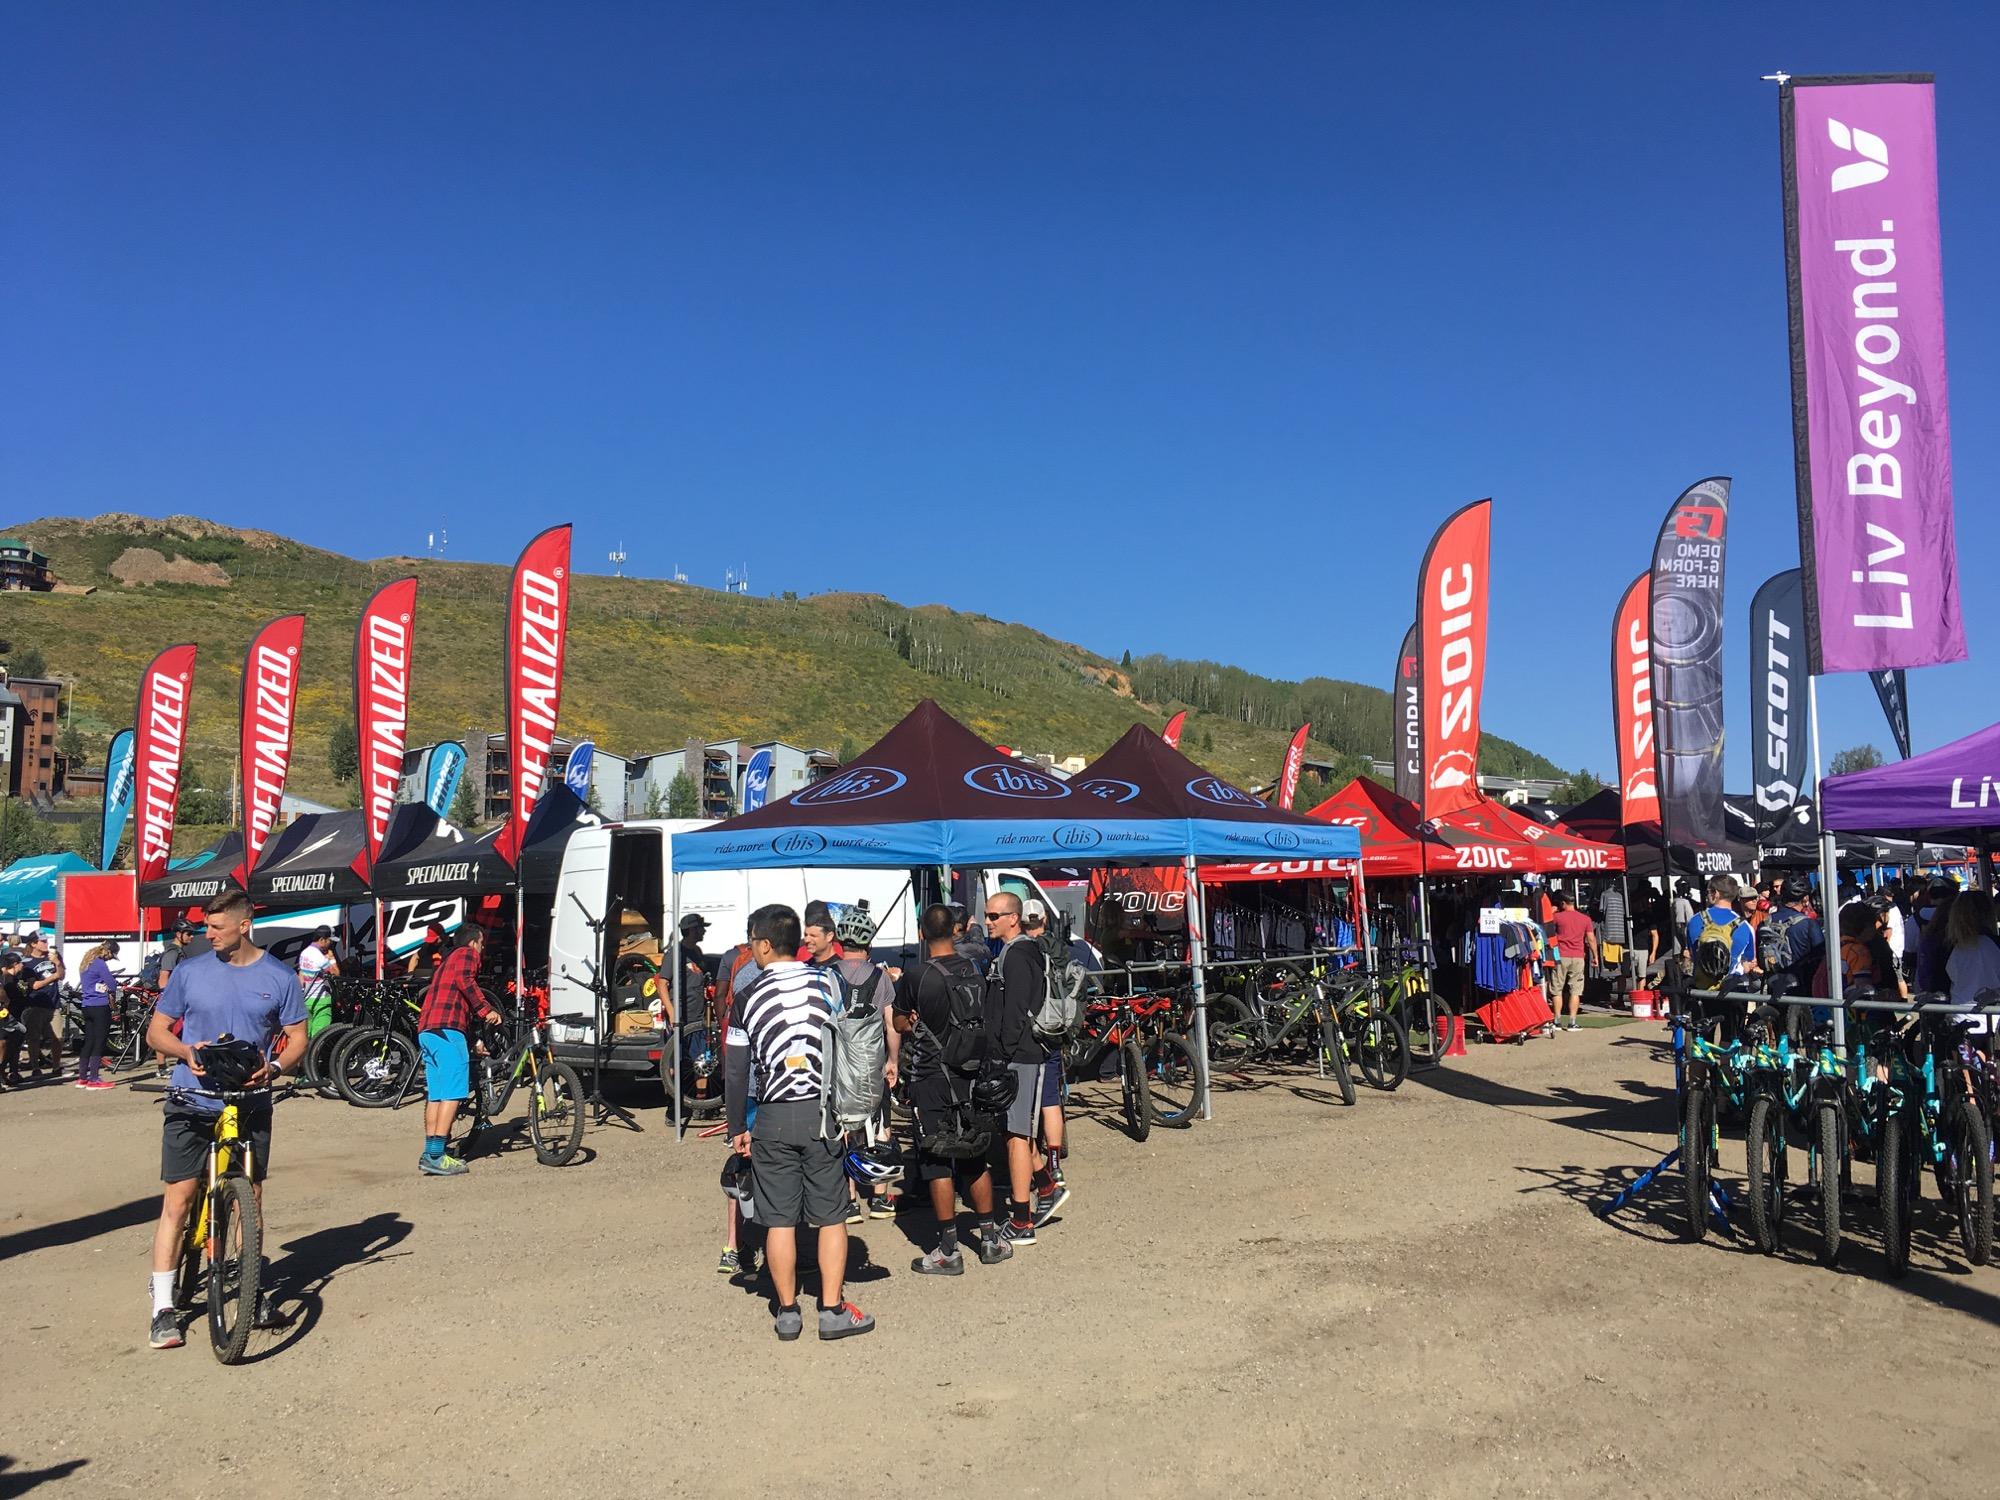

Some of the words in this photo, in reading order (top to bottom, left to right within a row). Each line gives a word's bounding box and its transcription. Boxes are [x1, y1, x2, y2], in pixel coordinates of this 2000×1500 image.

[1835, 219, 1917, 500] Beyond.
[1851, 522, 1915, 630] Liv
[1767, 609, 1791, 776] SCOTT
[991, 767, 1050, 792] ibis
[784, 834, 814, 851] ibis
[995, 832, 1016, 845] ride
[1064, 827, 1091, 845] ibis
[1106, 831, 1132, 841] work
[1133, 831, 1150, 841] less
[1273, 831, 1293, 846] ibis
[1523, 825, 1550, 840] ZO
[1455, 846, 1513, 869] ZOIC
[1561, 848, 1609, 869] ZOIC
[1697, 852, 1733, 872] G-FORM
[1764, 847, 1787, 857] SCOTT
[1835, 849, 1847, 858] OTT
[270, 873, 326, 893] SPECIALIZED
[406, 862, 470, 886] SPECIALIZED
[168, 880, 219, 898] SPECIALIZED
